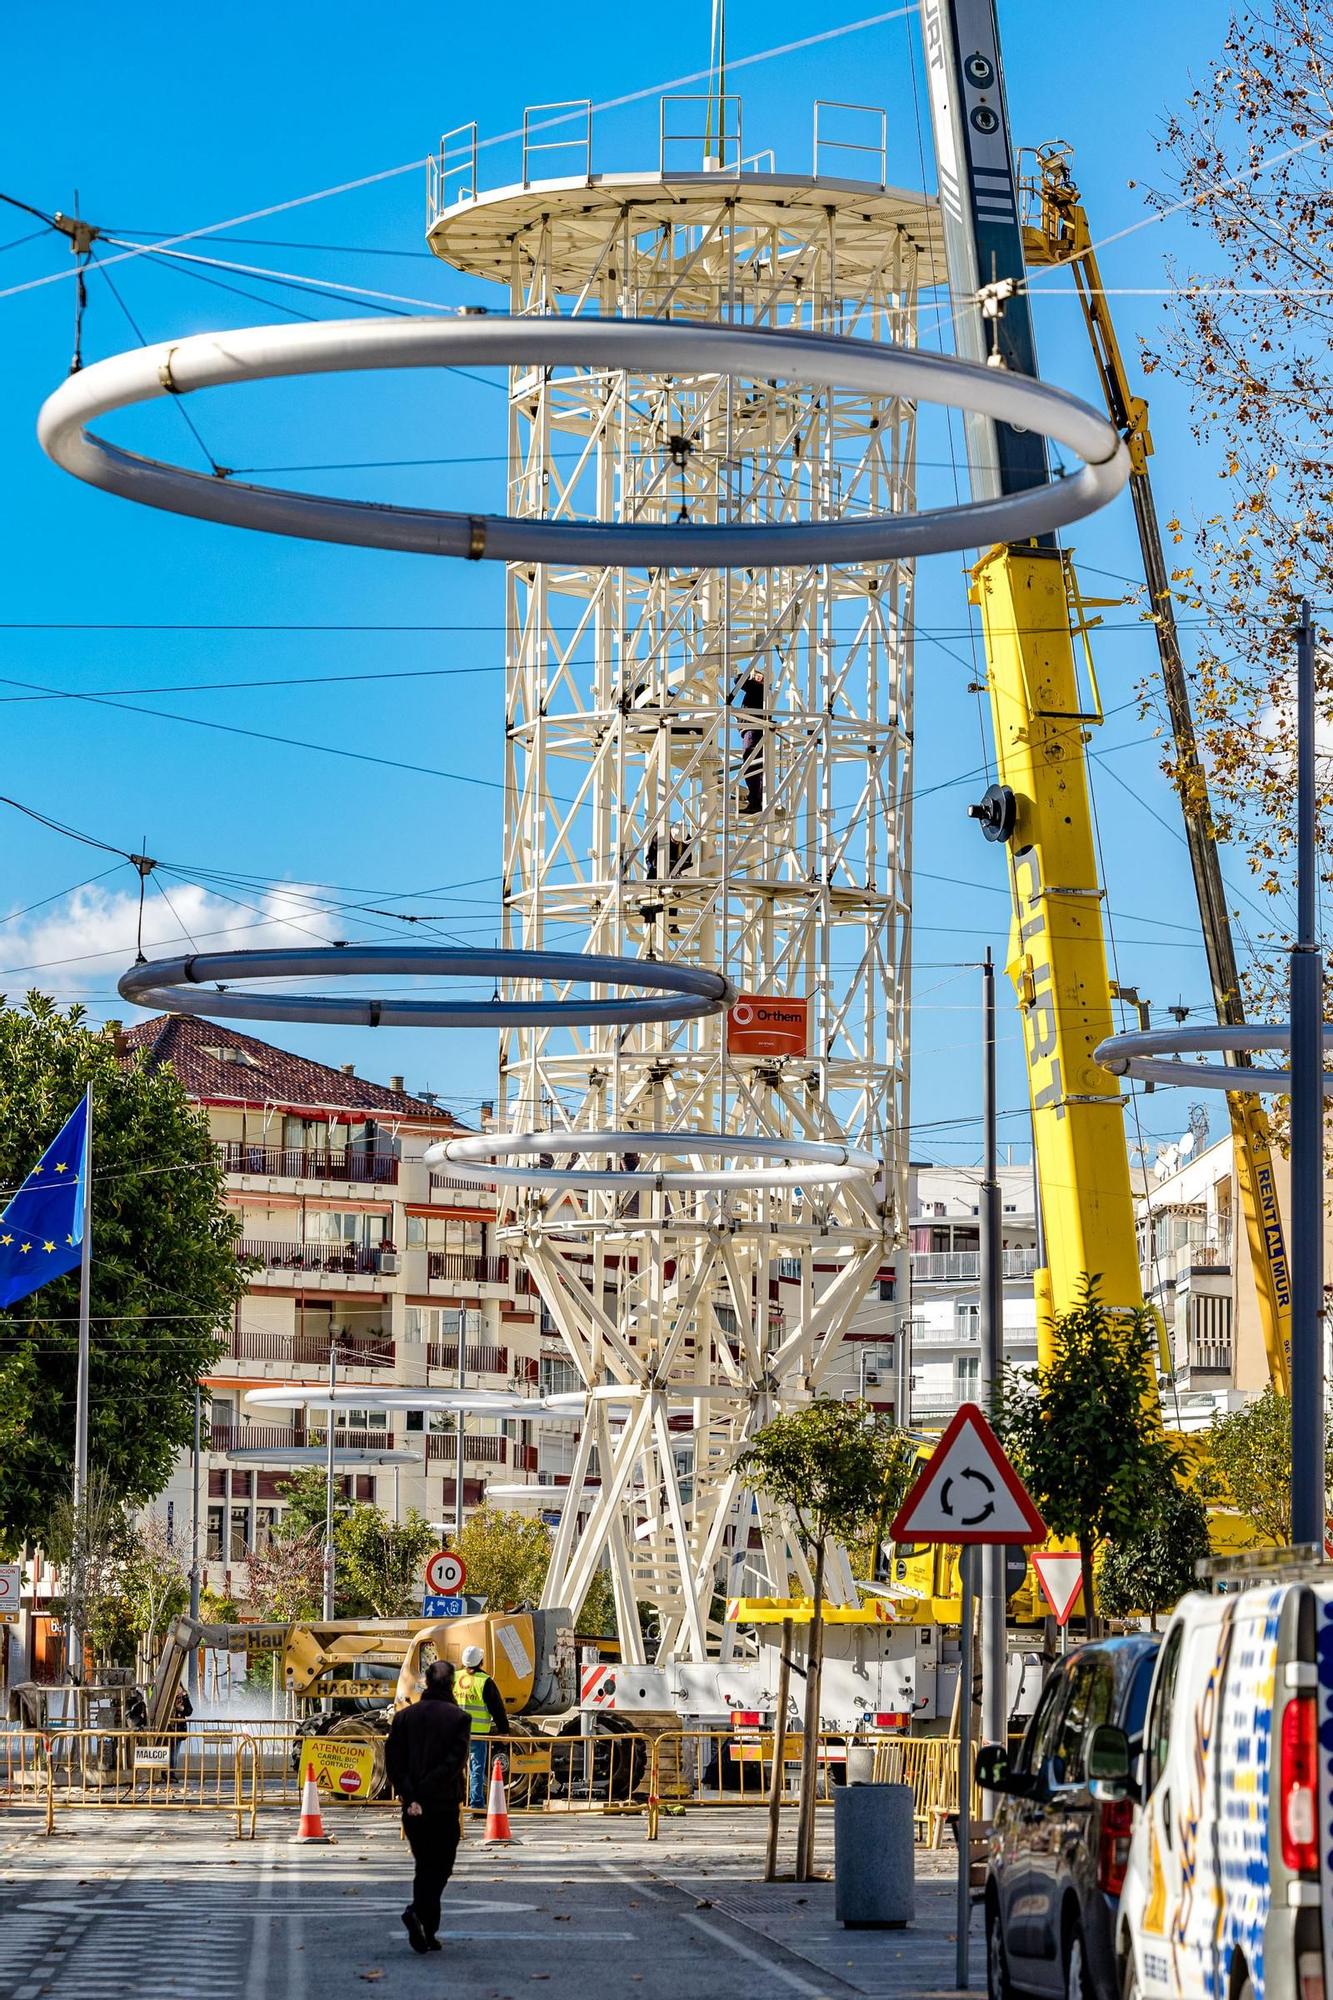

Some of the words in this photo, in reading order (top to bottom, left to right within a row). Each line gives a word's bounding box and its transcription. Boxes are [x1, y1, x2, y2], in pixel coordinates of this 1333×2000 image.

[757, 1009, 802, 1022] Orthem
[437, 1566, 456, 1581] 10
[136, 1750, 168, 1760] MALCOP
[317, 1752, 343, 1762] CARRIL
[320, 1760, 354, 1769] CORTADO
